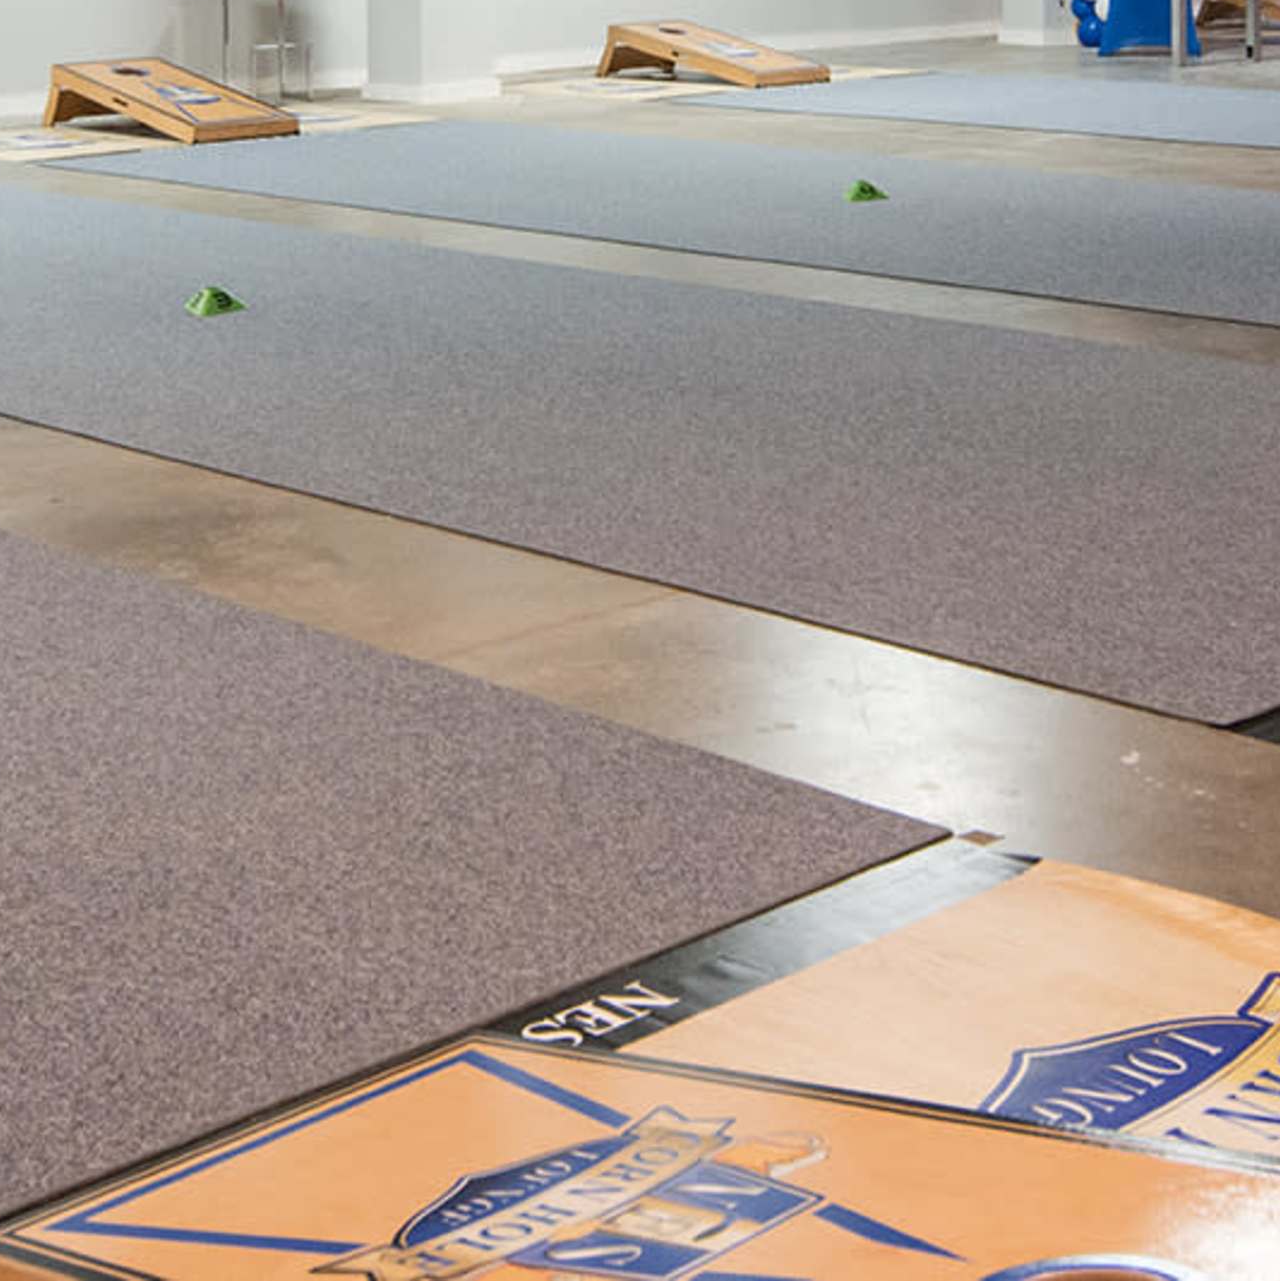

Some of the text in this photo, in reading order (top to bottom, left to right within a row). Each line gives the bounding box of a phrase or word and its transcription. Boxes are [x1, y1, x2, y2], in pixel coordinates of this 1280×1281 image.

[521, 980, 680, 1047] NES
[417, 1128, 707, 1268] CORN HOLE
[440, 1149, 601, 1226] LOUNGE
